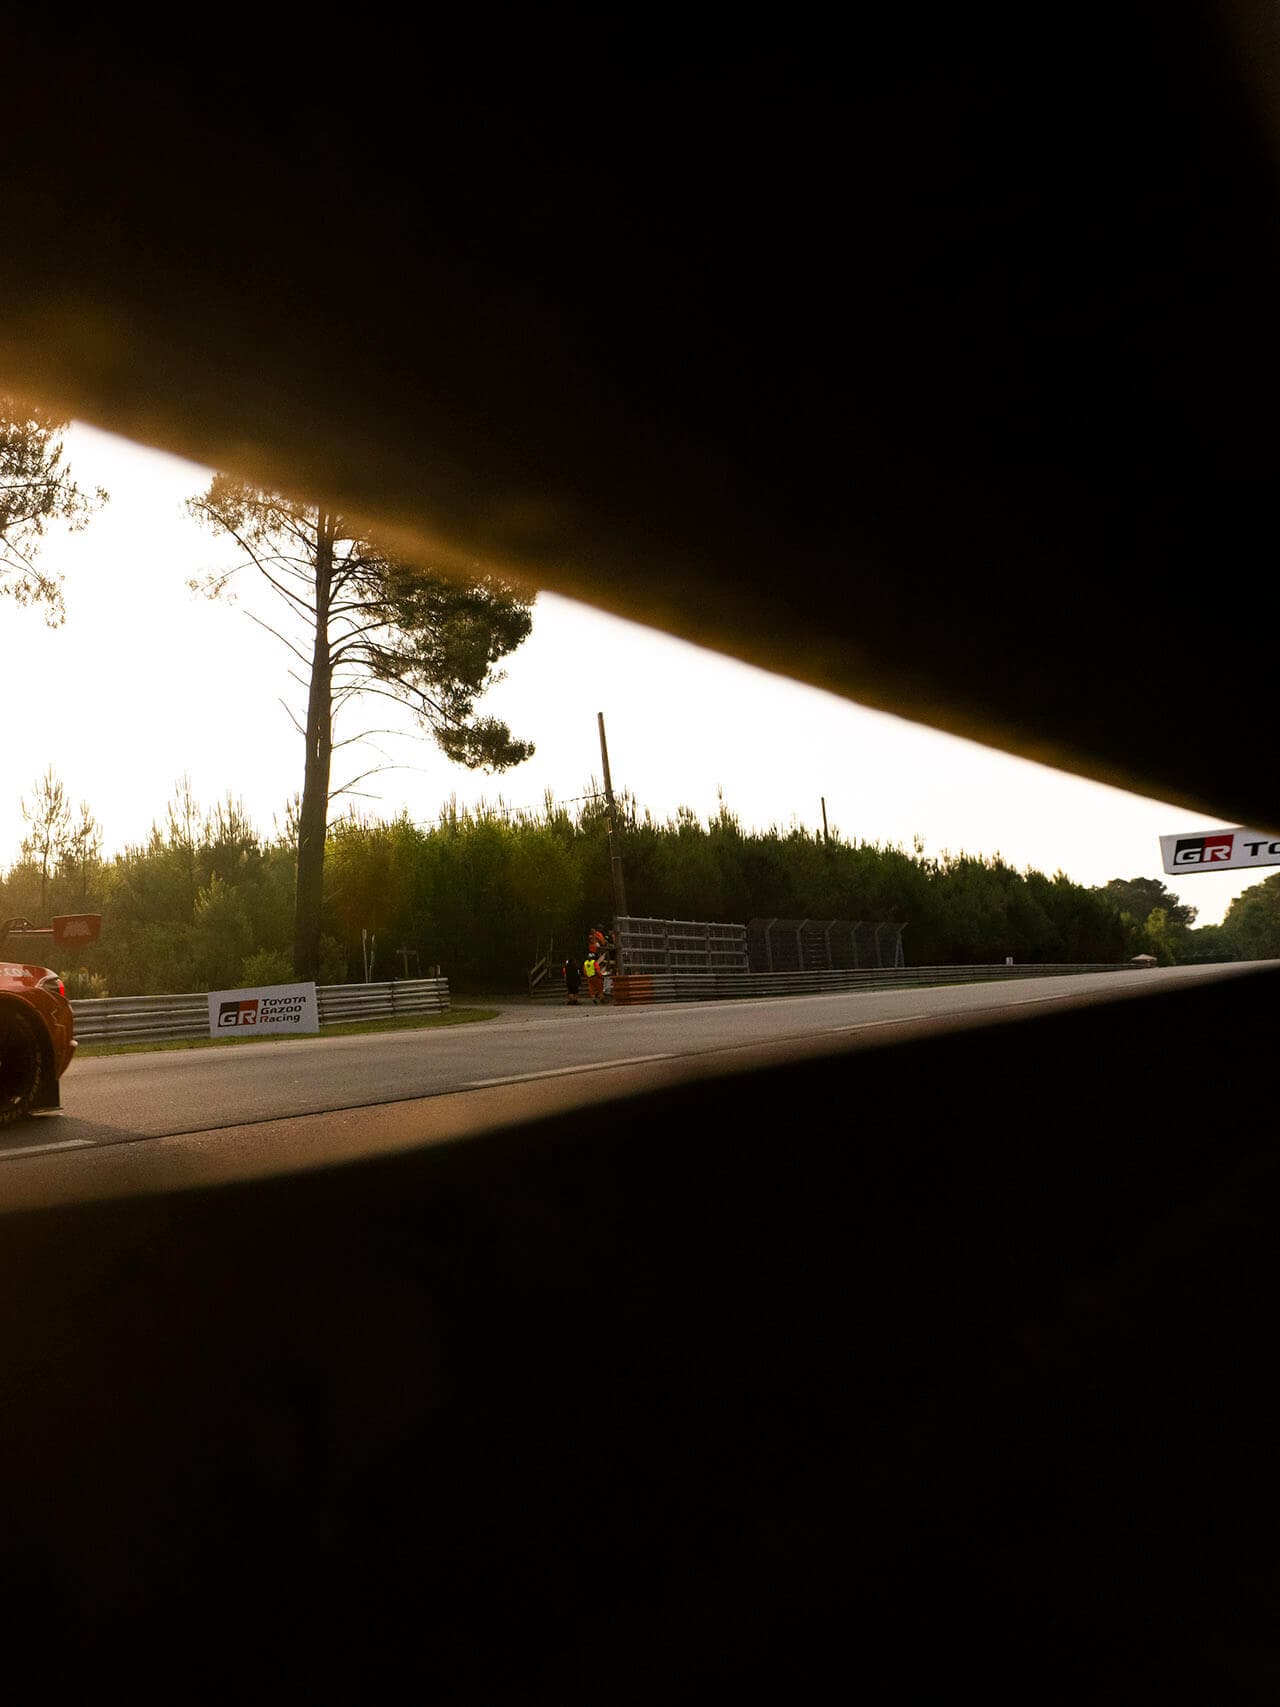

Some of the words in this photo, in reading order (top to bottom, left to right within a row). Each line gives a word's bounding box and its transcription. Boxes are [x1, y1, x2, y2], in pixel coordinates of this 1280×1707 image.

[1176, 845, 1231, 864] GR
[261, 996, 306, 1006] TOYOTA
[261, 1005, 302, 1015] GAZOO
[220, 1009, 256, 1026] GR
[260, 1013, 300, 1023] Racing
